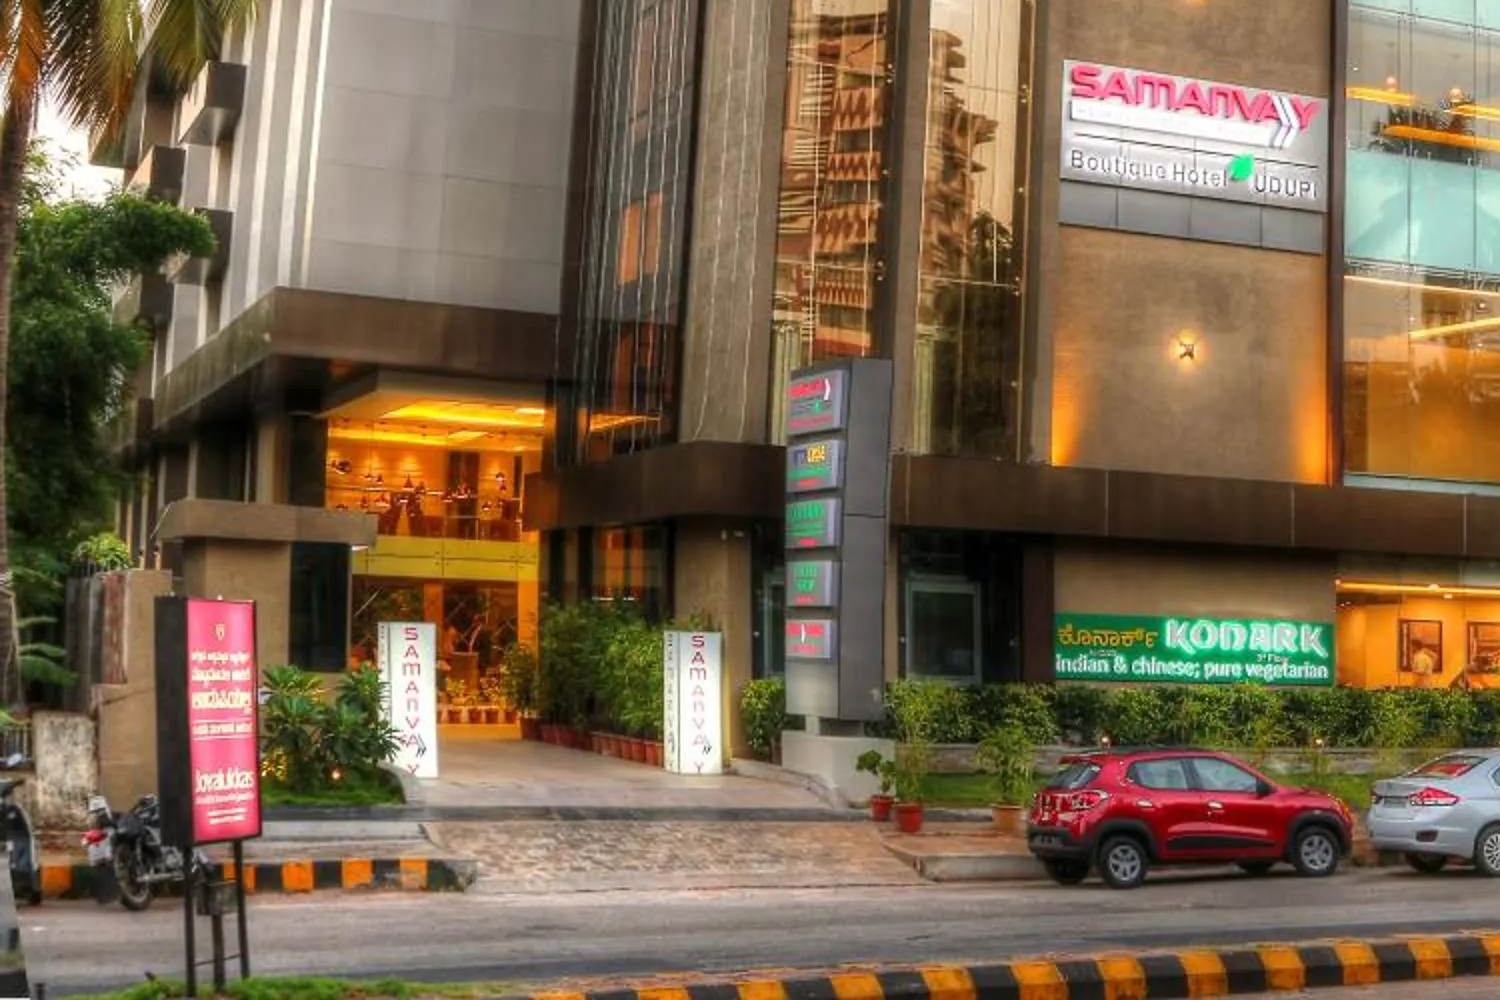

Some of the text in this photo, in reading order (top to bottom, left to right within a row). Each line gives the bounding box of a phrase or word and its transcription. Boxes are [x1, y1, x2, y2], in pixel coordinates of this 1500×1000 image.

[1070, 64, 1320, 130] SAMANVAY
[1070, 149, 1317, 199] Boutique Hotel UDUPI
[1164, 618, 1329, 658] KONARK
[1113, 654, 1129, 674] &
[1203, 661, 1243, 680] pure
[1245, 660, 1329, 682] vegetarian
